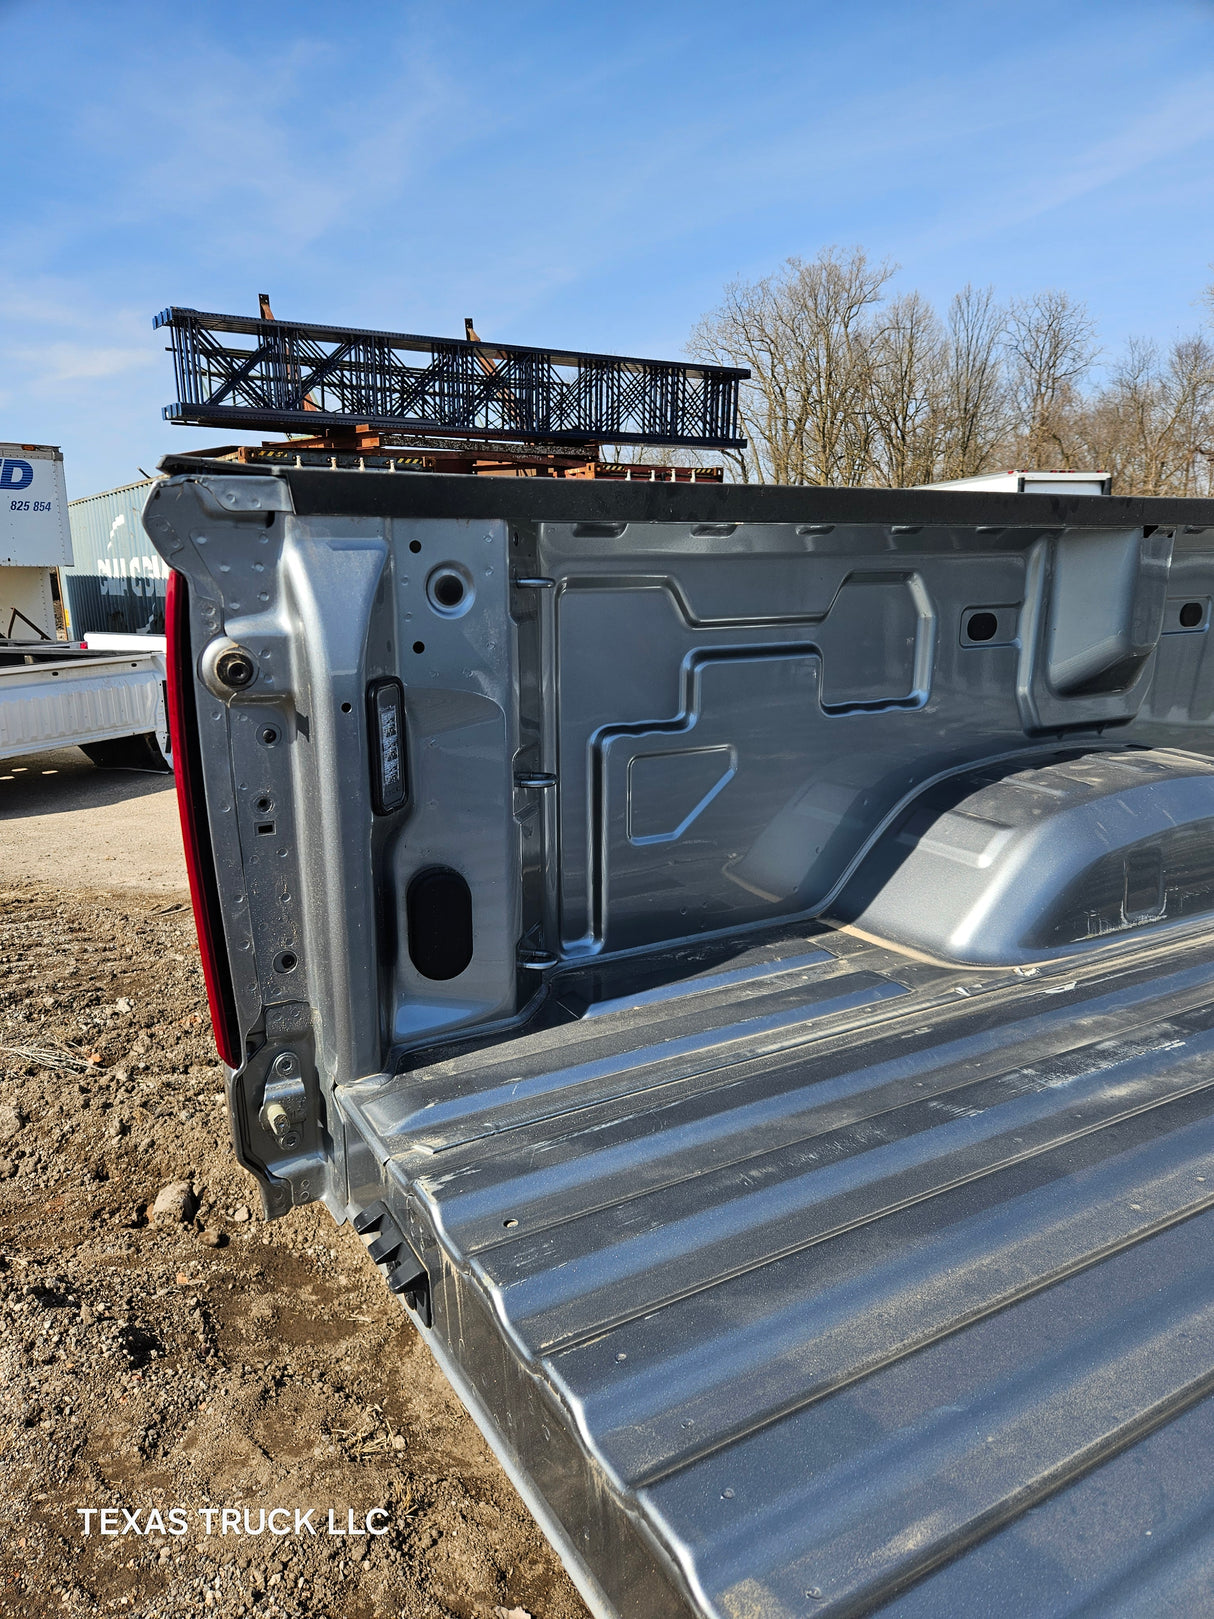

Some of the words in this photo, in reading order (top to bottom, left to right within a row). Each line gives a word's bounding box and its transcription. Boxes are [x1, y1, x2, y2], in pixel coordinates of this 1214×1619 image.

[0, 458, 33, 490] D
[10, 500, 30, 511] 825
[33, 501, 51, 512] 854
